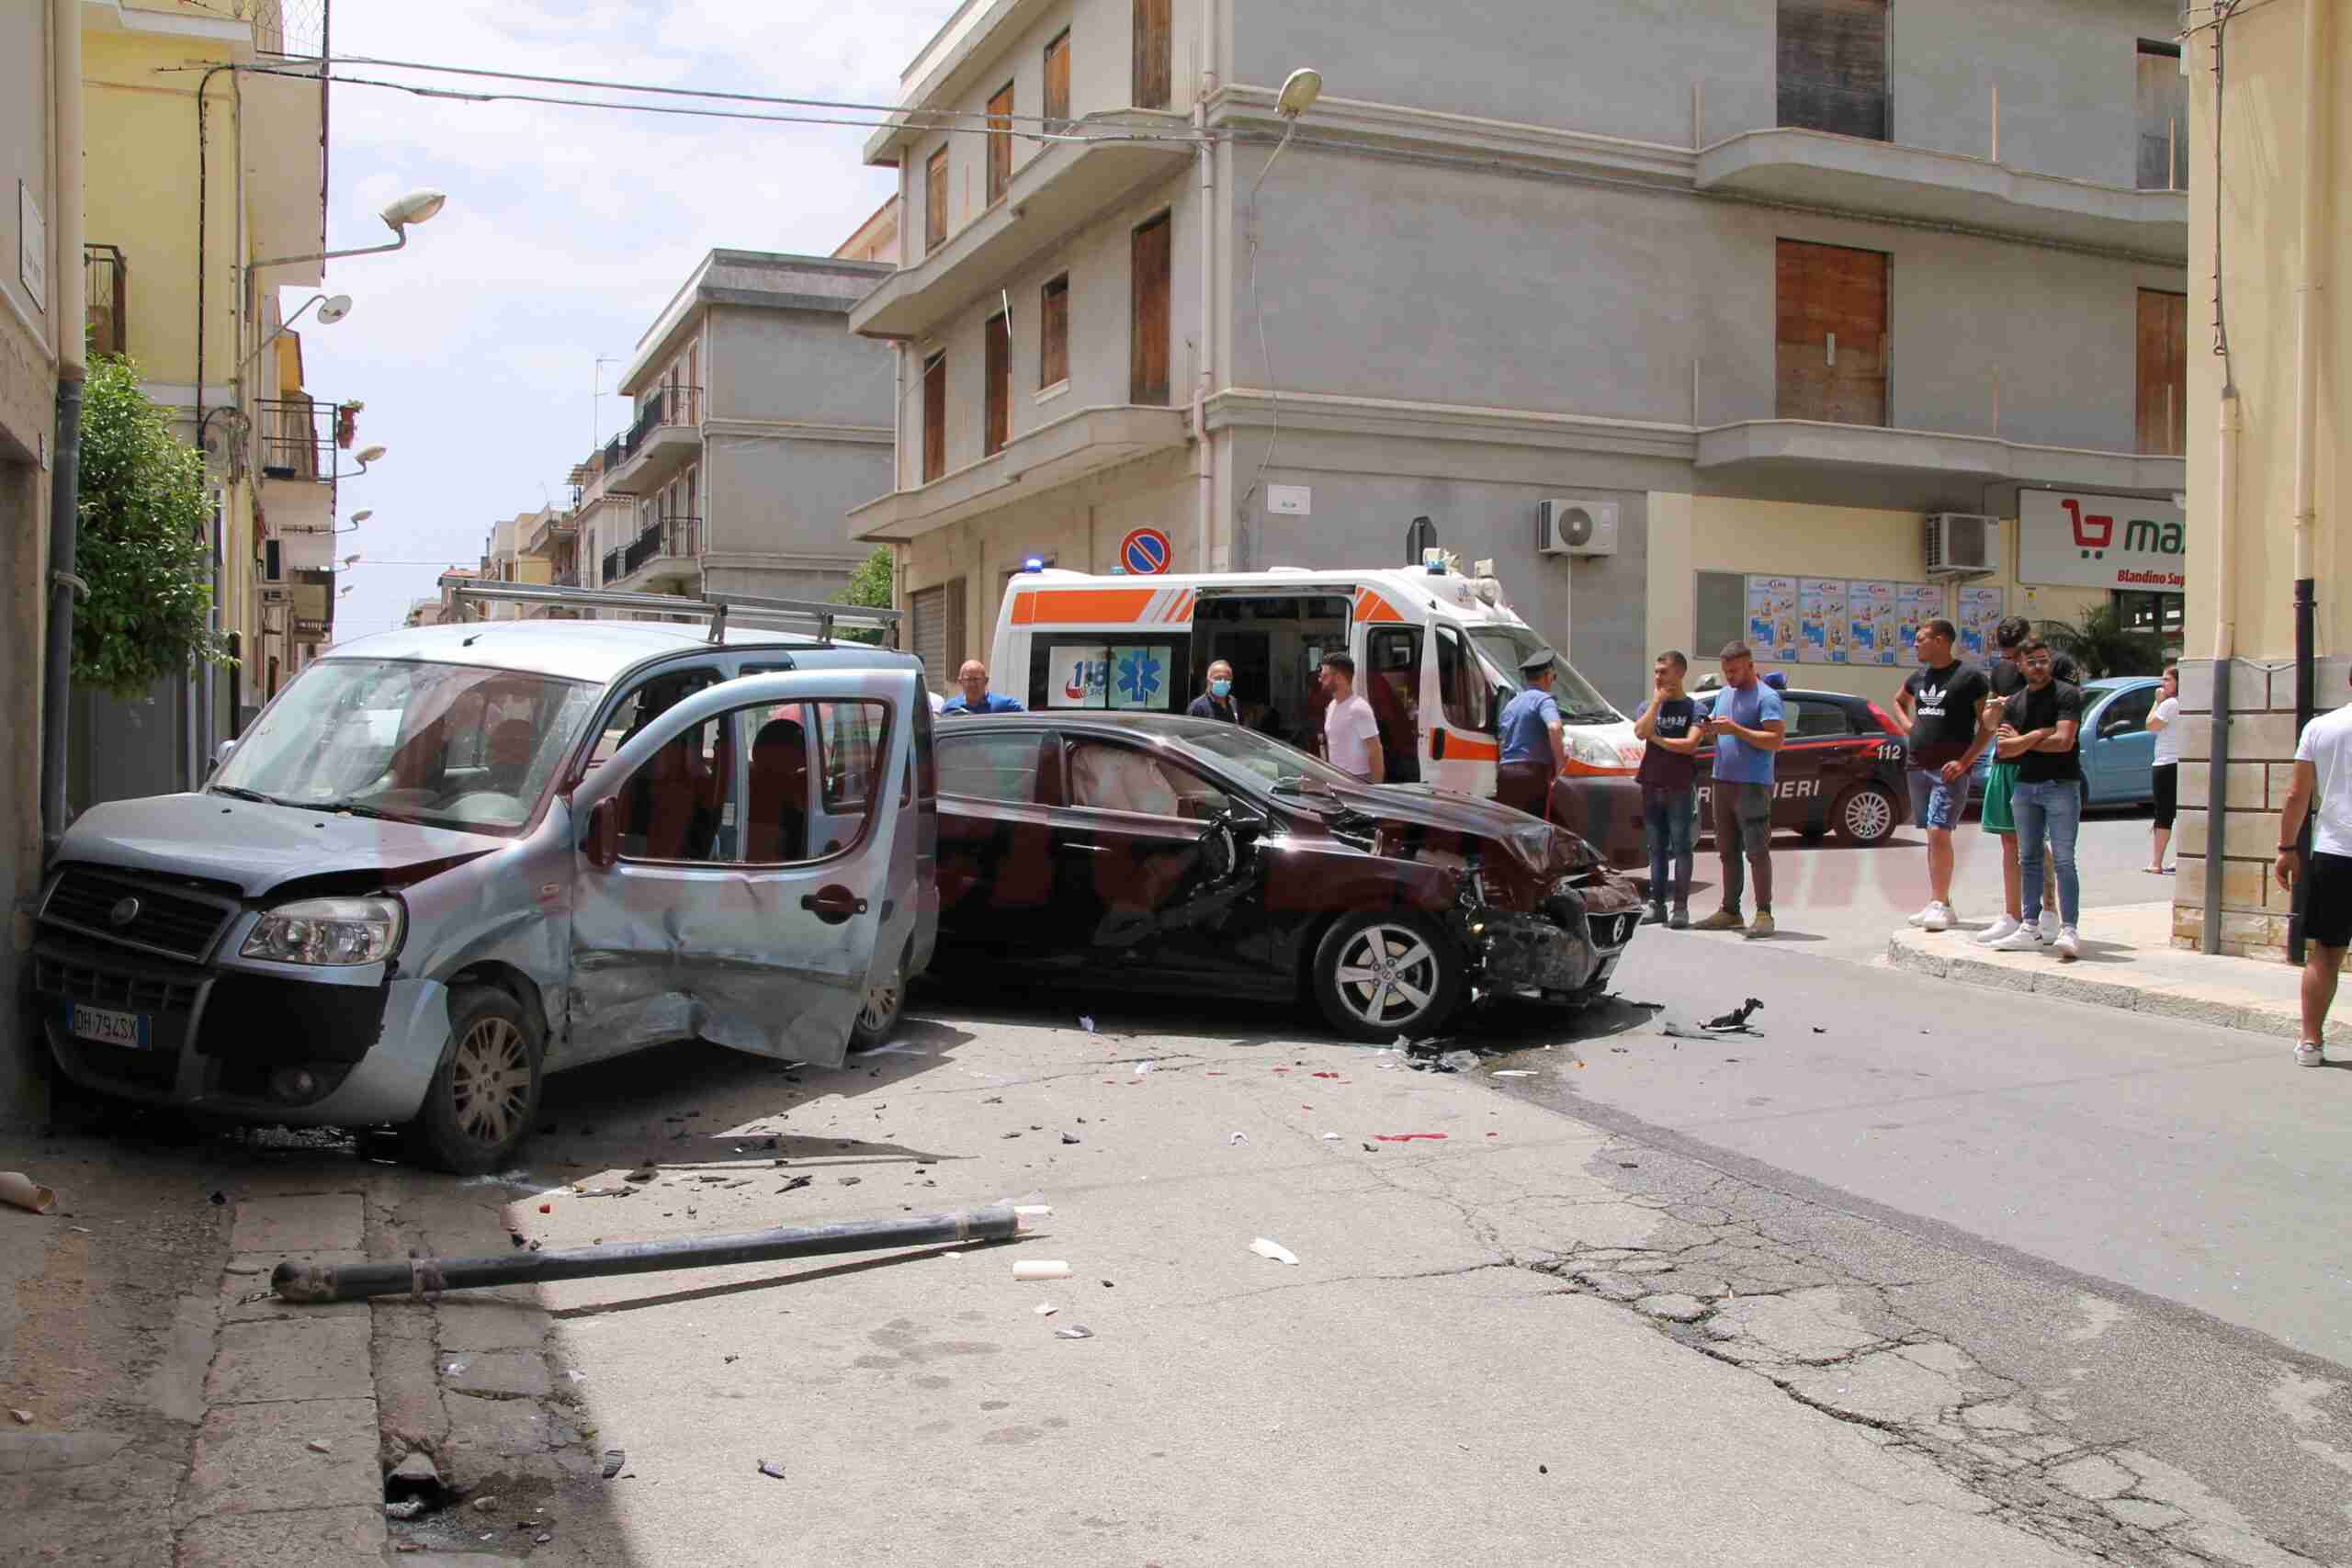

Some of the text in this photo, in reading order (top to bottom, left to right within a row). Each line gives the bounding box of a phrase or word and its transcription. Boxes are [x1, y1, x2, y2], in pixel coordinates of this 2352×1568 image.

[2117, 570, 2165, 584] Blandino
[1072, 660, 1107, 688] 118
[1917, 706, 1946, 716] adidas
[1877, 744, 1901, 760] 112
